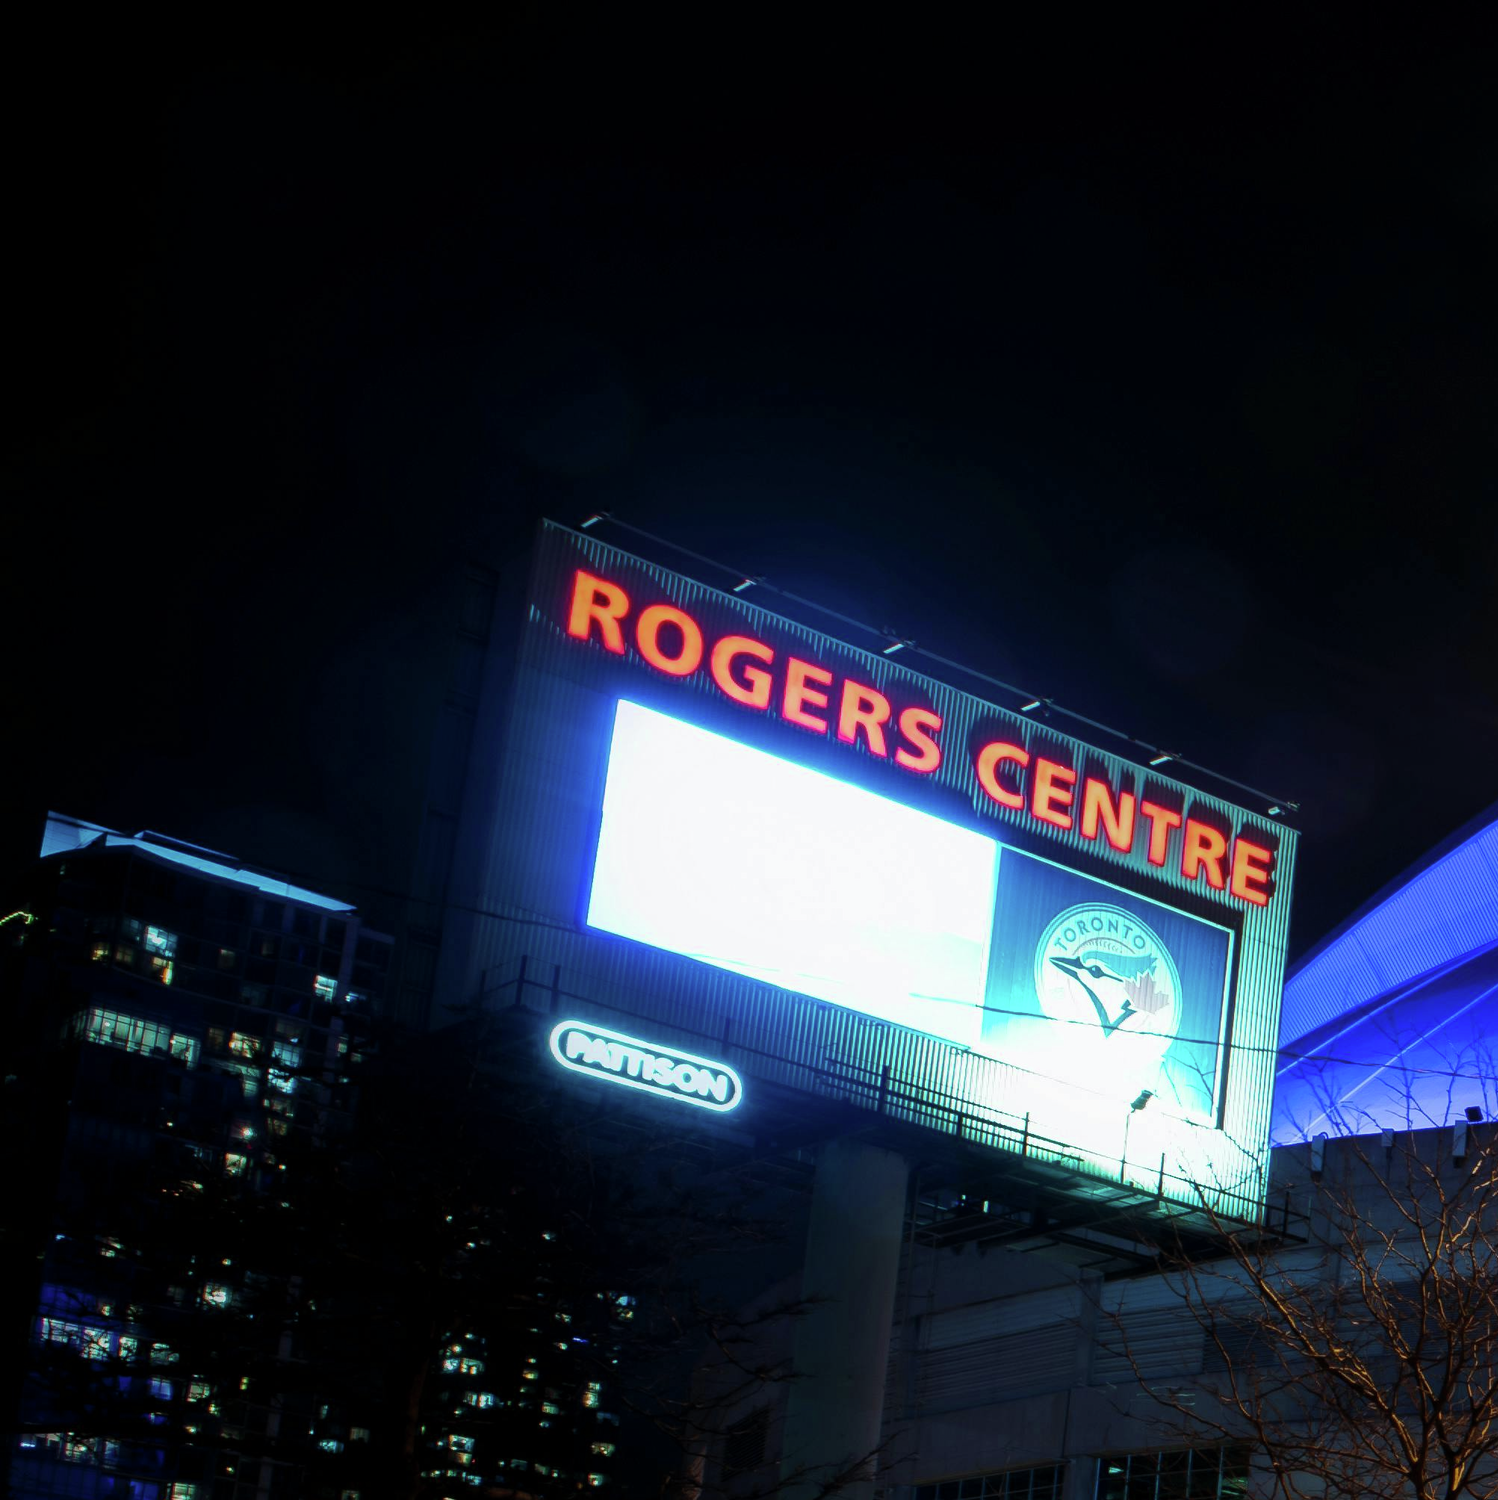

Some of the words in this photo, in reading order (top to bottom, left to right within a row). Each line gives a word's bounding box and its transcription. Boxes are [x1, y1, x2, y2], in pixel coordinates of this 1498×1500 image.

[565, 569, 944, 774] ROGERS
[974, 741, 1273, 907] CENTRE
[1054, 916, 1146, 951] TORONTO
[565, 1030, 728, 1102] PATTISON
